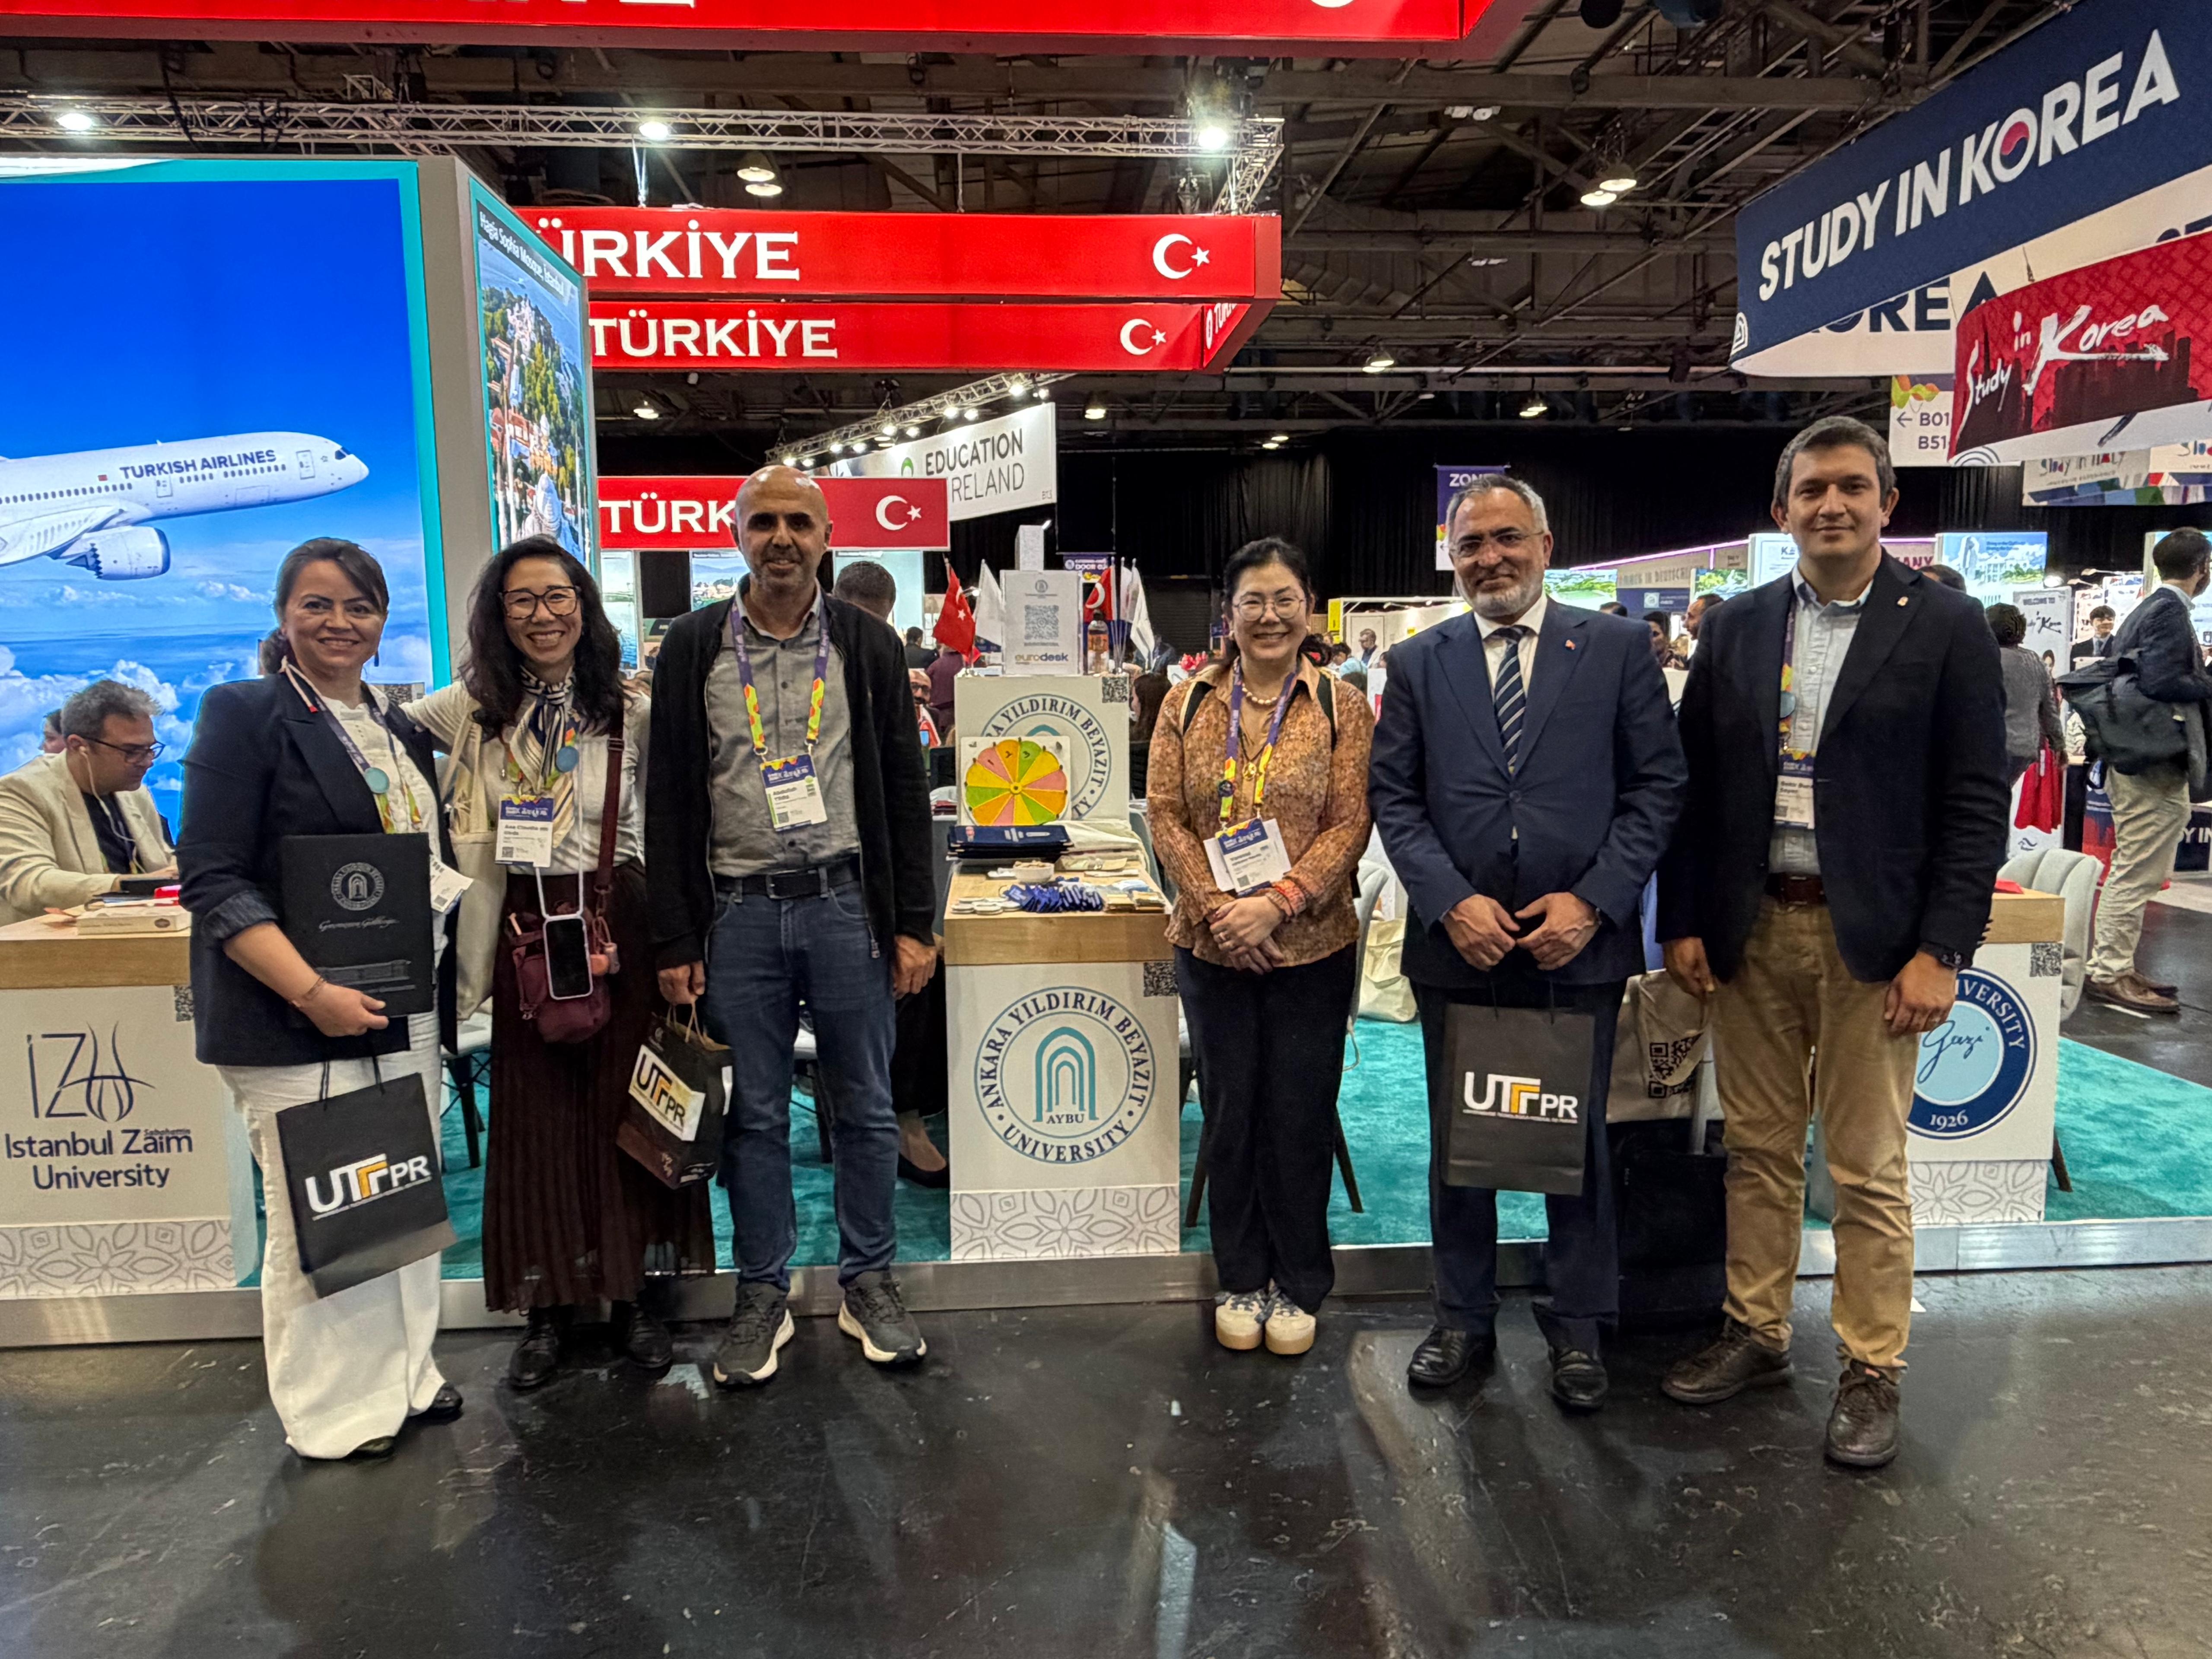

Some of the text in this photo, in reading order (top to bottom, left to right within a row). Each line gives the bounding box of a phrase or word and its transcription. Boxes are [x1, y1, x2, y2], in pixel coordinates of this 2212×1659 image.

[1758, 29, 2180, 302] STUDY IN KOREA
[588, 309, 837, 358] TÜRKİYE
[2021, 305, 2169, 396] Korea
[1955, 340, 2012, 441] Study
[1920, 412, 1950, 426] B01
[119, 449, 276, 480] TURKISH AIRLINES
[925, 428, 1023, 476] EDUCATION
[1015, 653, 1068, 661] eurodesk
[1001, 698, 1107, 788] YILDIRIM BEYAZIT
[981, 992, 1150, 1109] ANKARA YILDIRIM BEYAZIT
[1046, 1113, 1085, 1124] AYBU
[1930, 1110, 1968, 1131] 1926
[4, 1129, 193, 1159] Istanbul Zaim
[1003, 1119, 1130, 1162] UNIVERSITY
[32, 1163, 170, 1190] University
